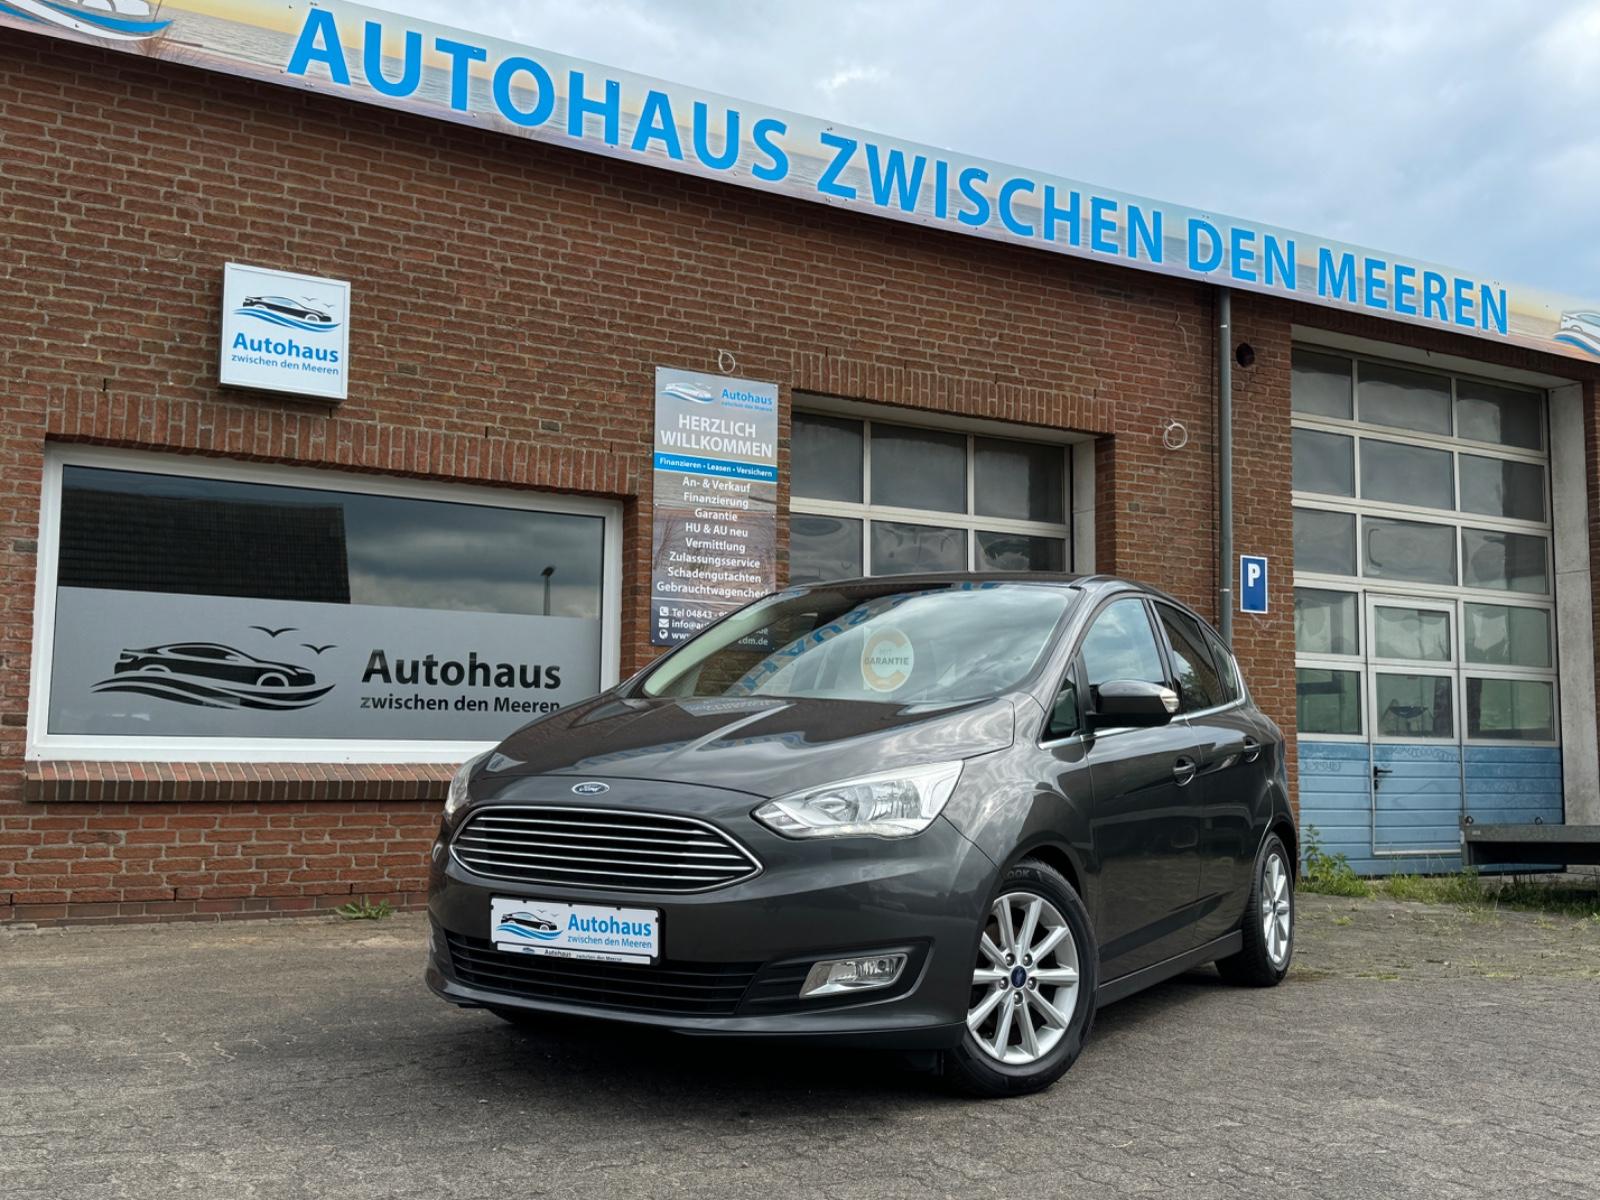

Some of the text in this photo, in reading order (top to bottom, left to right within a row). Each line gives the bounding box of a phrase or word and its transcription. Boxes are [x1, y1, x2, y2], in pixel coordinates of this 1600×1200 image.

[286, 7, 1508, 336] AUTOHAUS ZWISCHEN DEN MEEREN
[232, 332, 339, 363] Autohaus
[231, 354, 339, 376] zwischen den Meeren
[721, 388, 773, 406] Autohaus
[678, 414, 756, 438] HERZLICH
[660, 430, 773, 458] WILLKOMMEN
[659, 457, 773, 478] Finanzieren Leasen Versichern
[682, 476, 751, 493] An- & Verkauf
[683, 492, 749, 510] Finanzierung
[694, 508, 738, 521] Garantie
[685, 522, 748, 538] HU & AU neu
[685, 537, 746, 554] Vermittlung
[669, 551, 761, 569] Zulassungsservice
[667, 567, 762, 583] Schadengutachten
[1247, 562, 1262, 588] P
[671, 607, 684, 618] Tel
[361, 649, 562, 690] Autohaus
[360, 694, 560, 713] zwischen den Meeren
[567, 913, 652, 937] Autohaus
[567, 935, 652, 949] zwischen den Meeren
